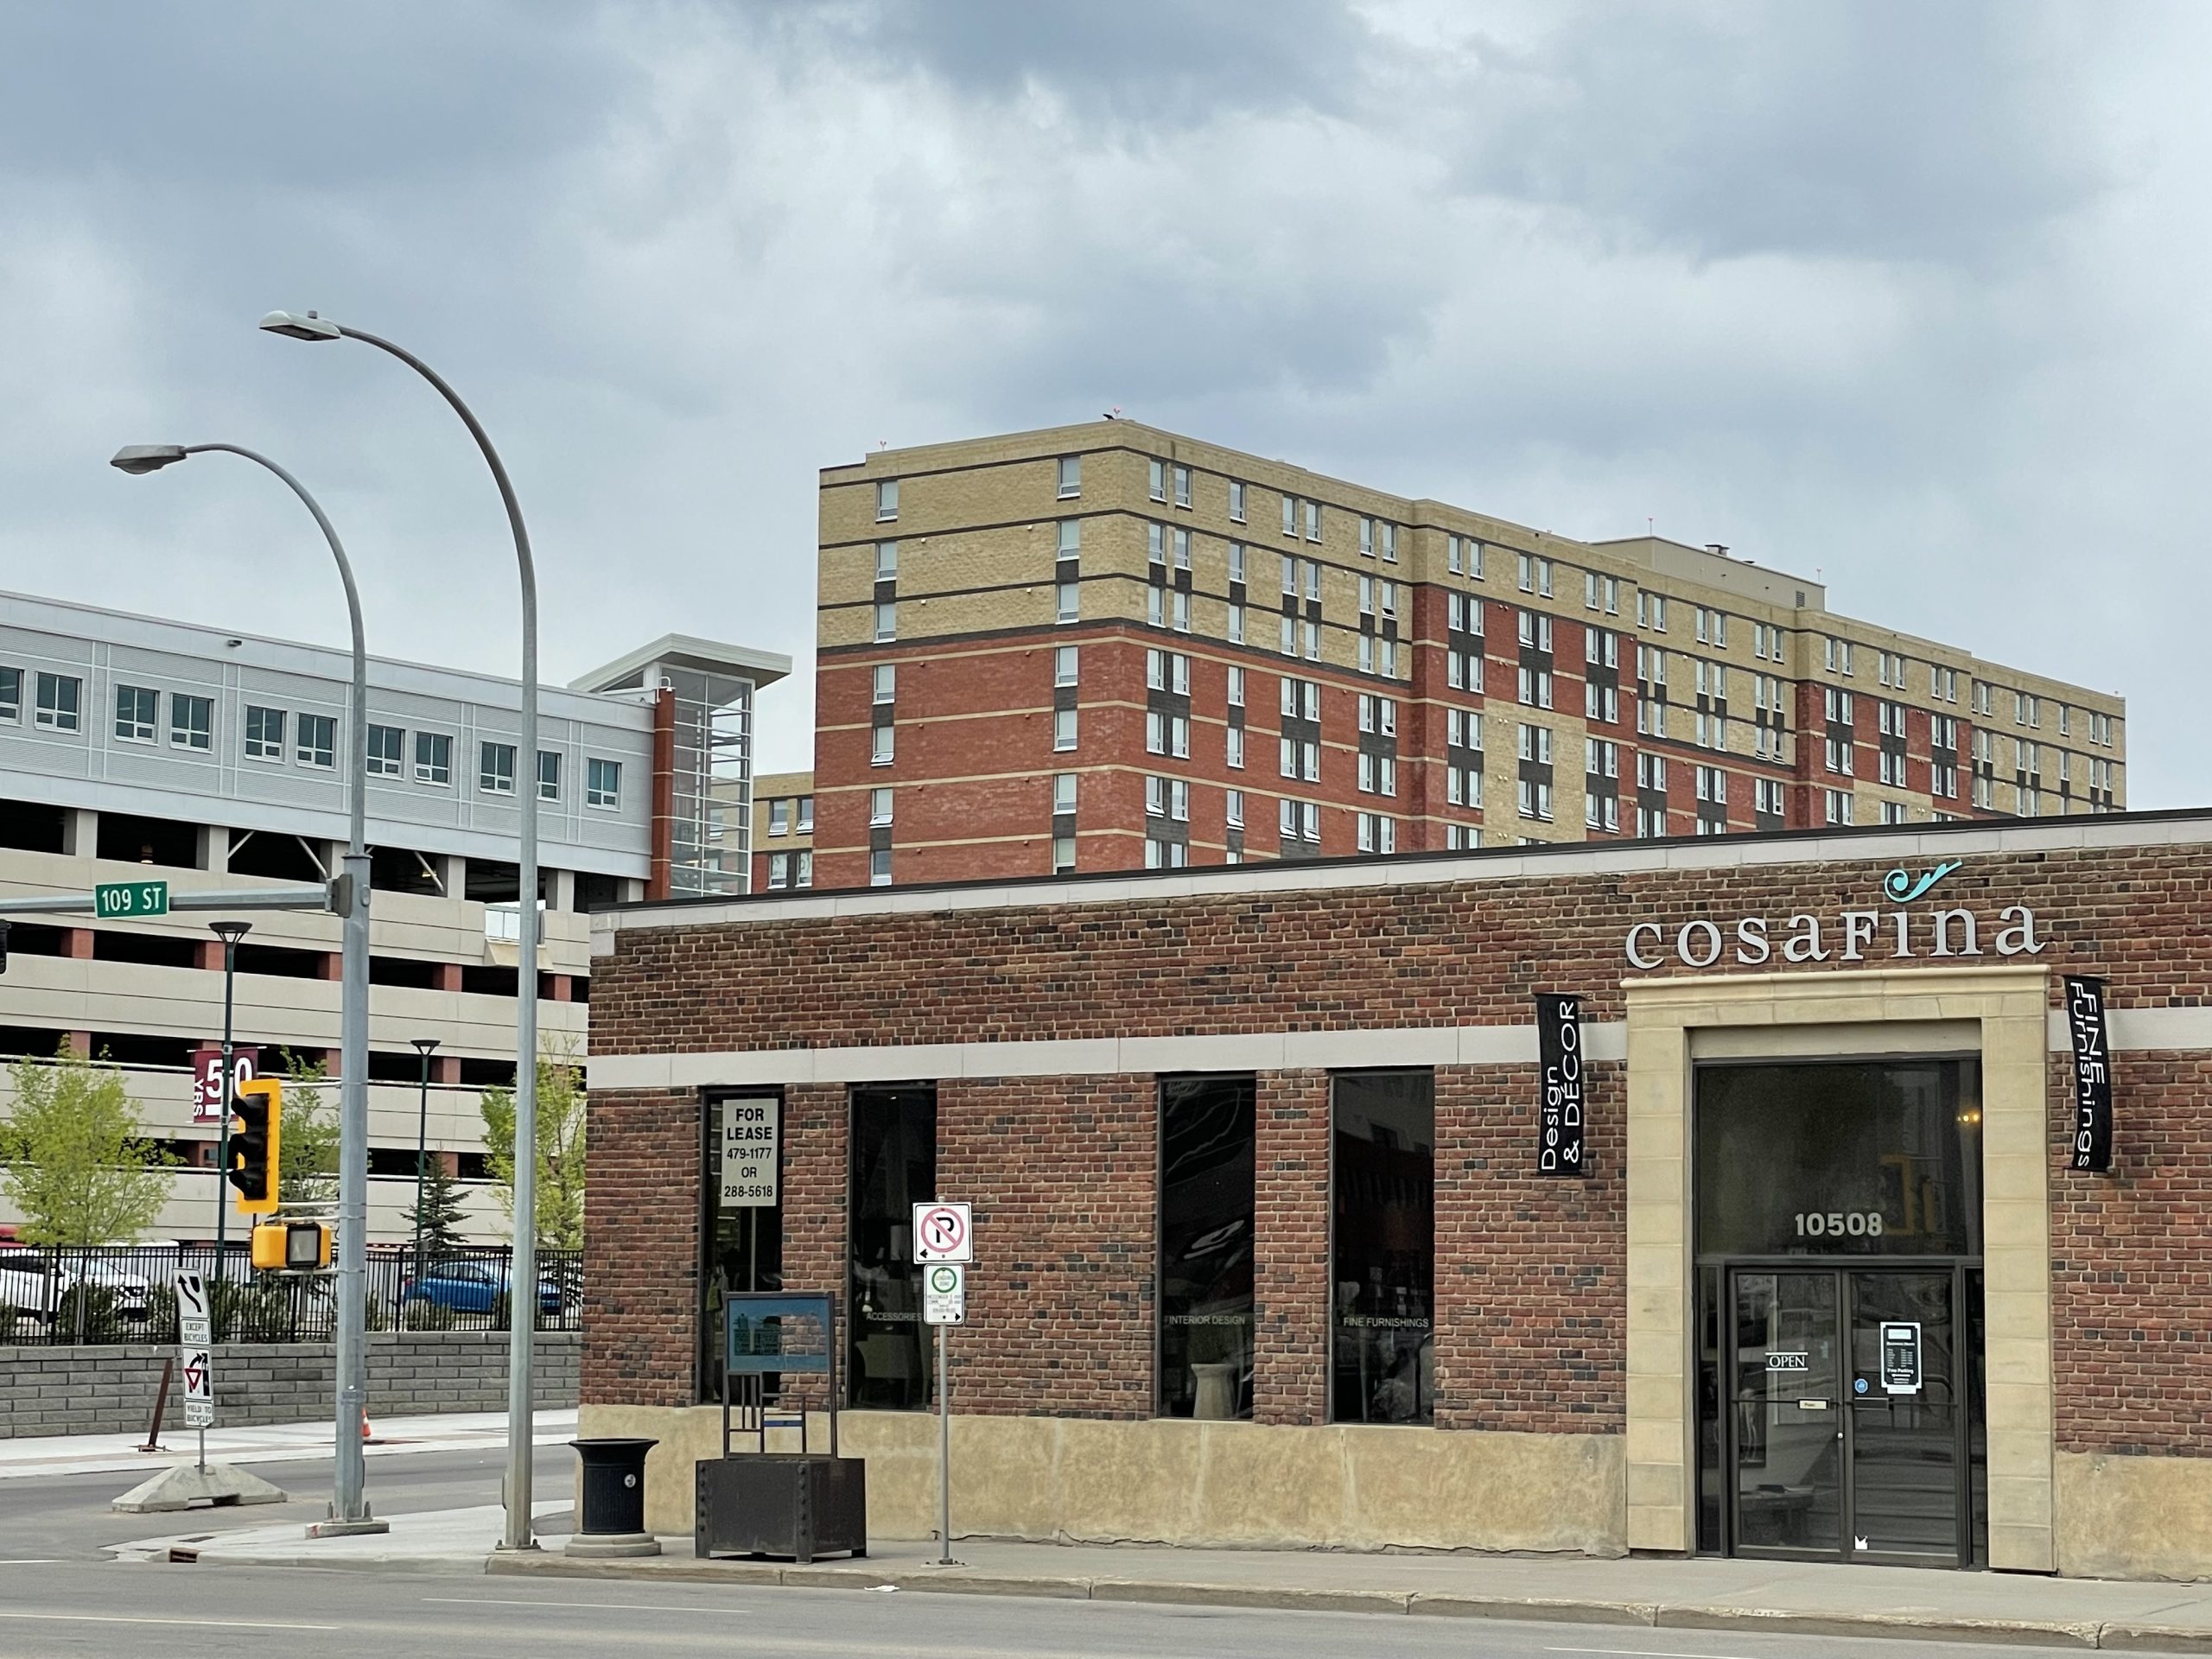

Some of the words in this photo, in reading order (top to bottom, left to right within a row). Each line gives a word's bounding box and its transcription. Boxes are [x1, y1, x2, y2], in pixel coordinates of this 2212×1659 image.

[101, 888, 131, 912] 109
[143, 887, 162, 910] ST
[2082, 993, 2105, 1084] FINE
[1559, 1001, 1580, 1127] DÉCOR
[206, 1057, 252, 1099] 50
[2070, 982, 2094, 1167] Furnishings
[194, 1078, 204, 1116] YRS
[735, 1108, 764, 1122] FOR
[1541, 1065, 1562, 1171] Design
[727, 1126, 772, 1141] LEASE
[727, 1147, 772, 1160] 479-1177
[1563, 1139, 1580, 1164] &
[741, 1166, 757, 1178] OR
[724, 1185, 772, 1198] 288-5618
[1795, 1211, 1883, 1237] 10508
[866, 1312, 923, 1321] ACCESSORIES
[1169, 1315, 1210, 1325] INTERIOR
[1211, 1315, 1245, 1325] DESIGN
[1344, 1317, 1364, 1327] FINE
[1366, 1317, 1429, 1328] FURNISHINGS
[186, 1322, 204, 1332] EXCEPT
[184, 1333, 208, 1343] BICYCLES
[1769, 1355, 1805, 1368] OPEN
[188, 1405, 201, 1414] YIELD
[204, 1406, 212, 1414] TO
